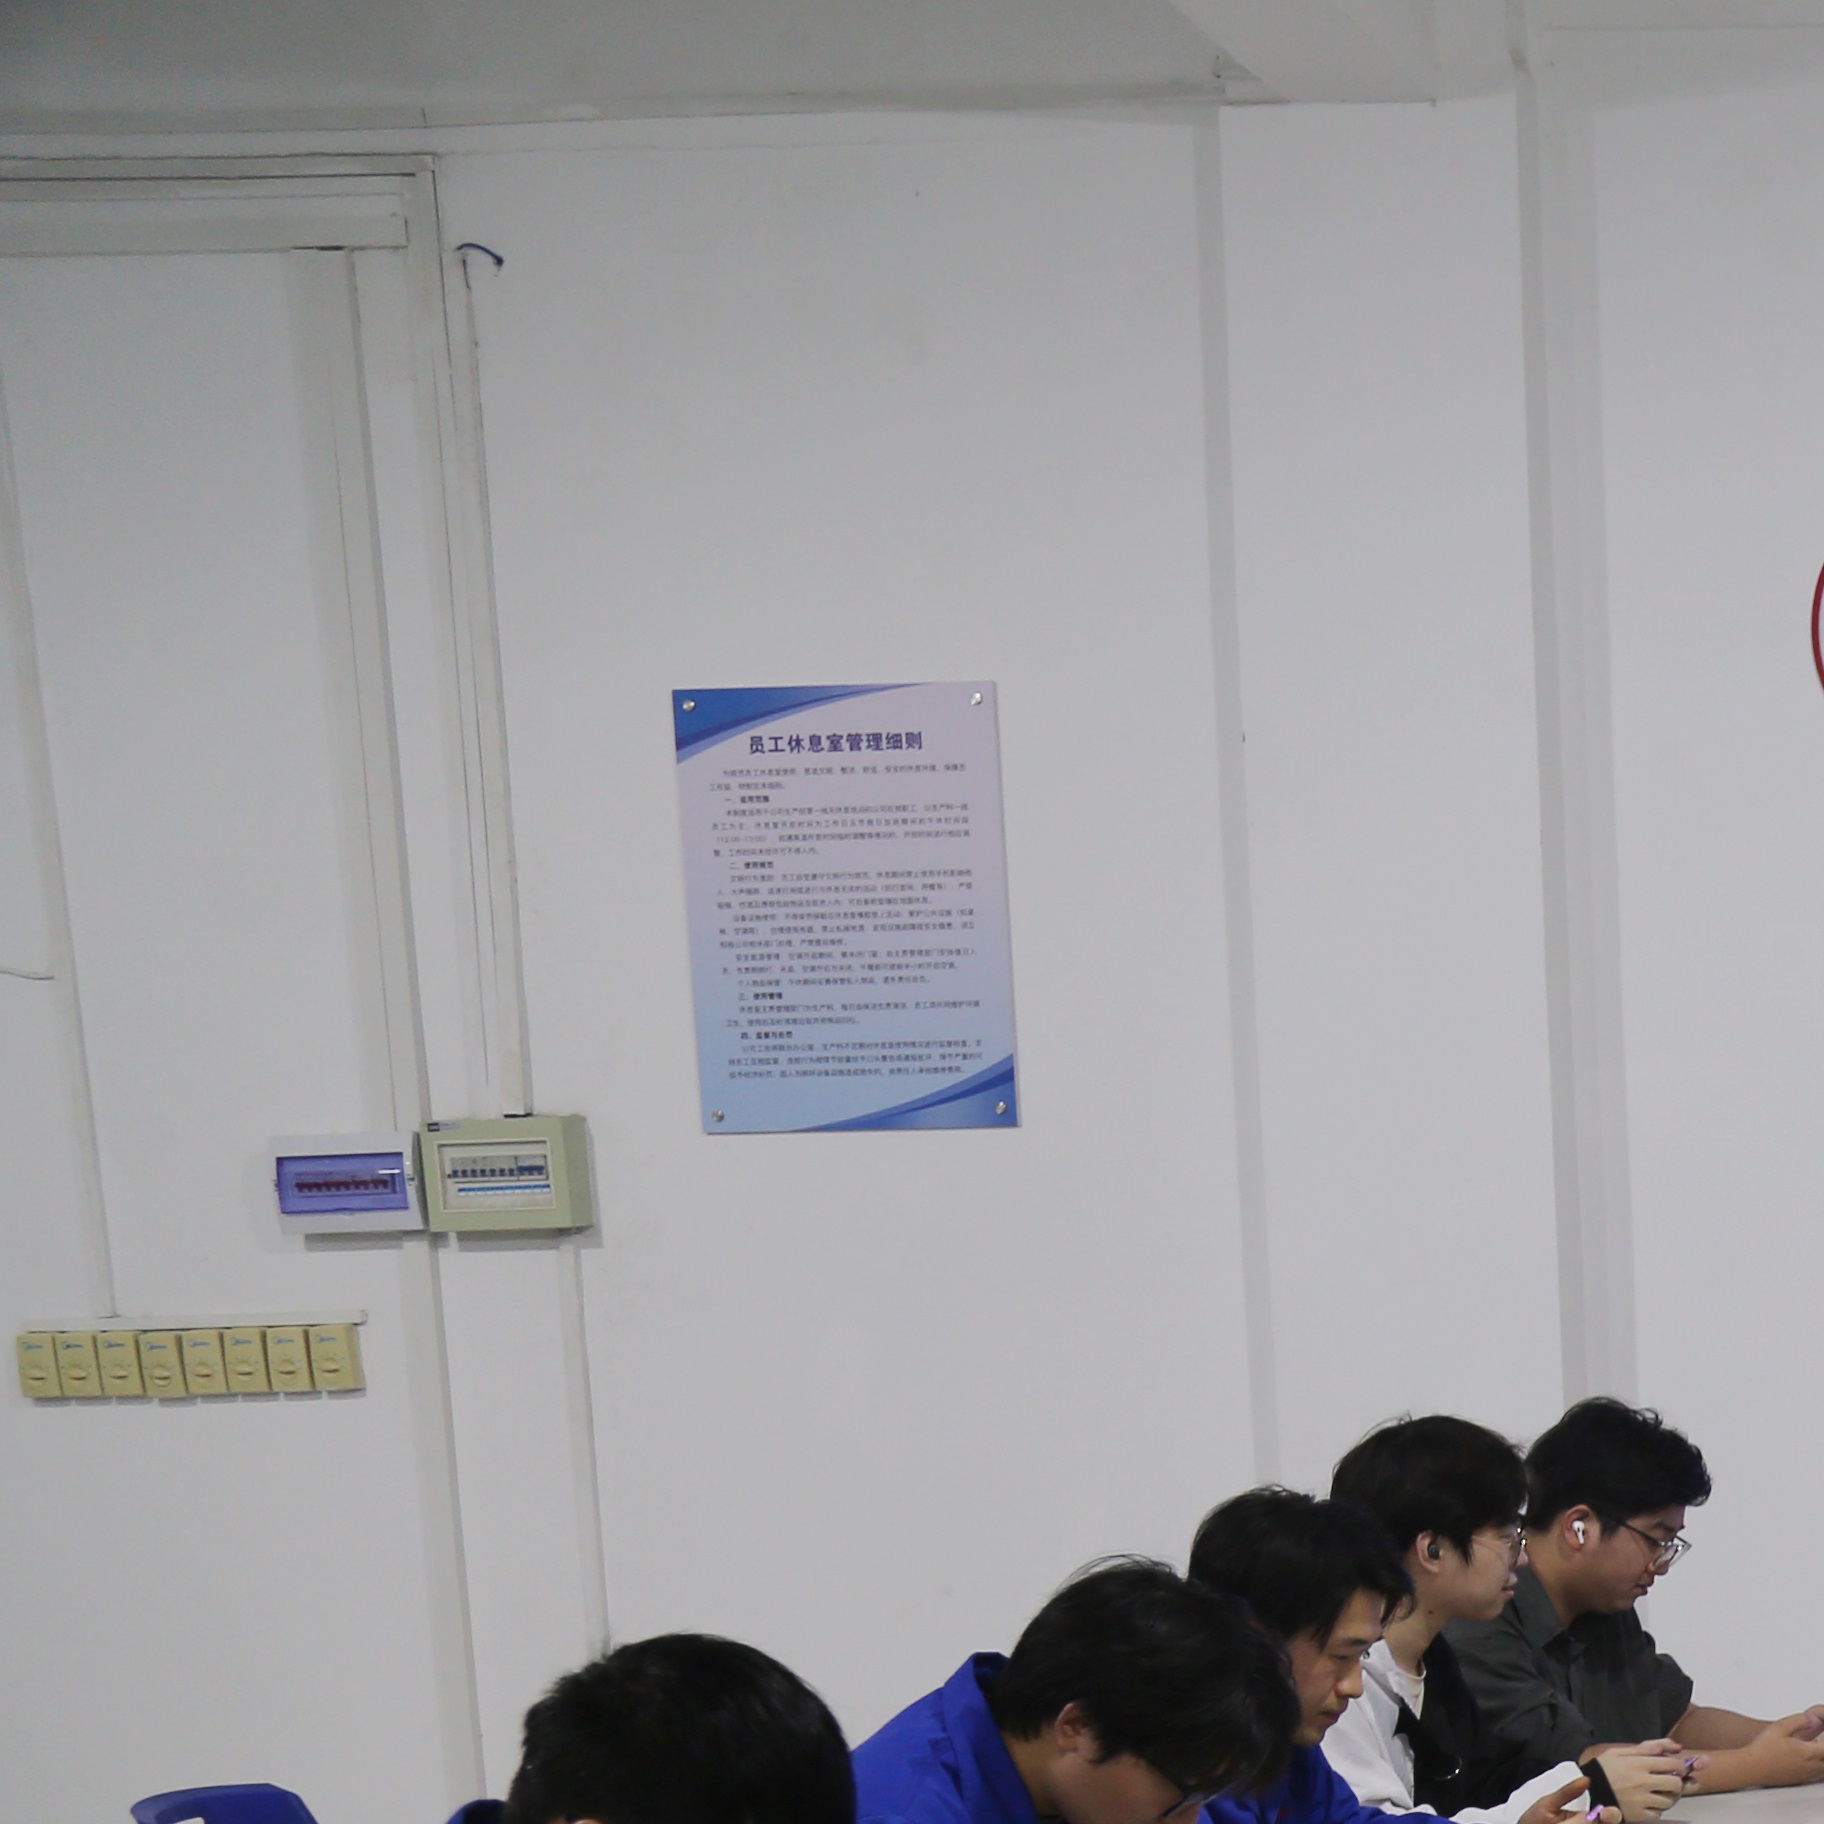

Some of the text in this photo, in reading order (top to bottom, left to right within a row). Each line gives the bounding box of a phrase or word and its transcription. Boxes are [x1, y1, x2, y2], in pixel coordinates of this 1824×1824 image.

[749, 731, 923, 755] 员工休息室管理细则
